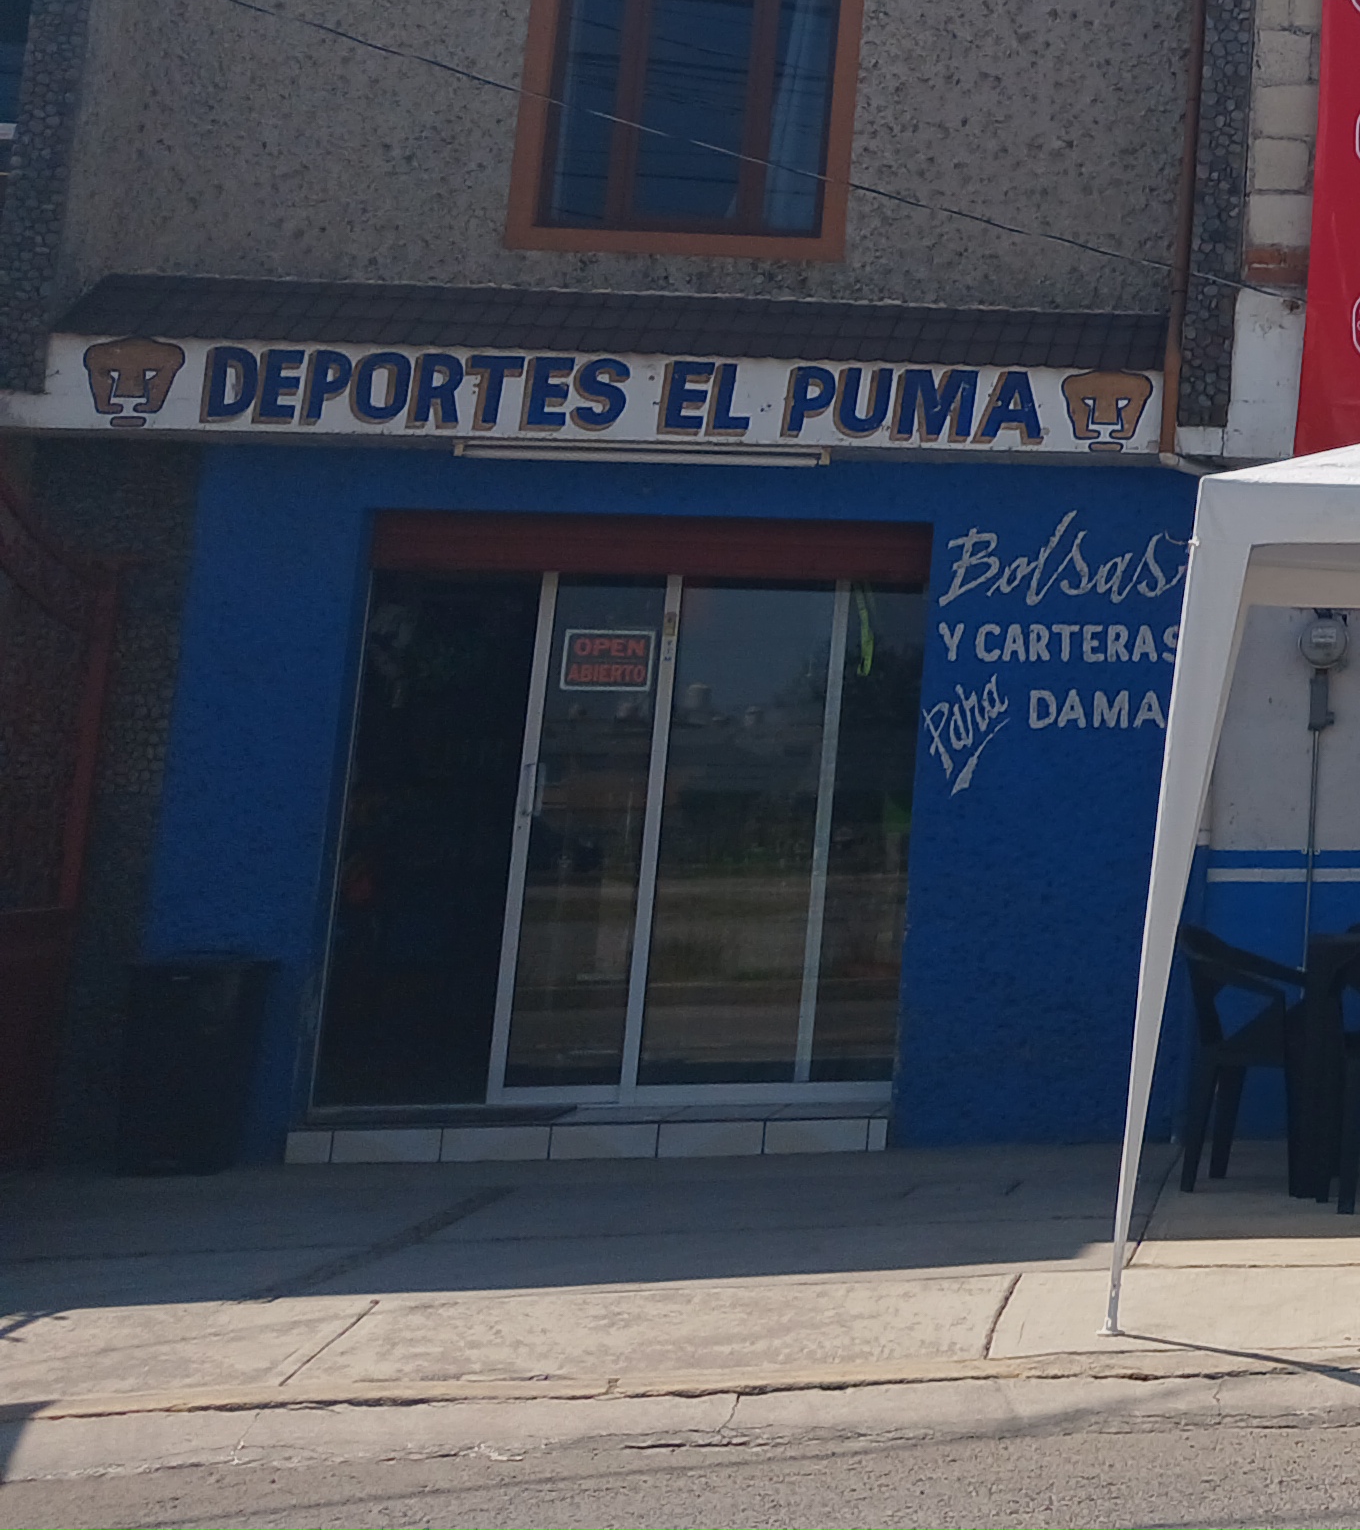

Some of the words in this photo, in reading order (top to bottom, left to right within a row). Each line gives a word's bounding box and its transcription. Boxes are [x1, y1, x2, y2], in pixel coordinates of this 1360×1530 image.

[199, 346, 632, 432] DEPORTES
[656, 360, 751, 437] EL
[780, 365, 1045, 445] PUMA
[573, 638, 646, 657] OPEN
[938, 623, 965, 662] Y
[975, 623, 1179, 663] CARTERAS
[567, 663, 647, 683] ABIERTO
[923, 673, 1008, 780] Para
